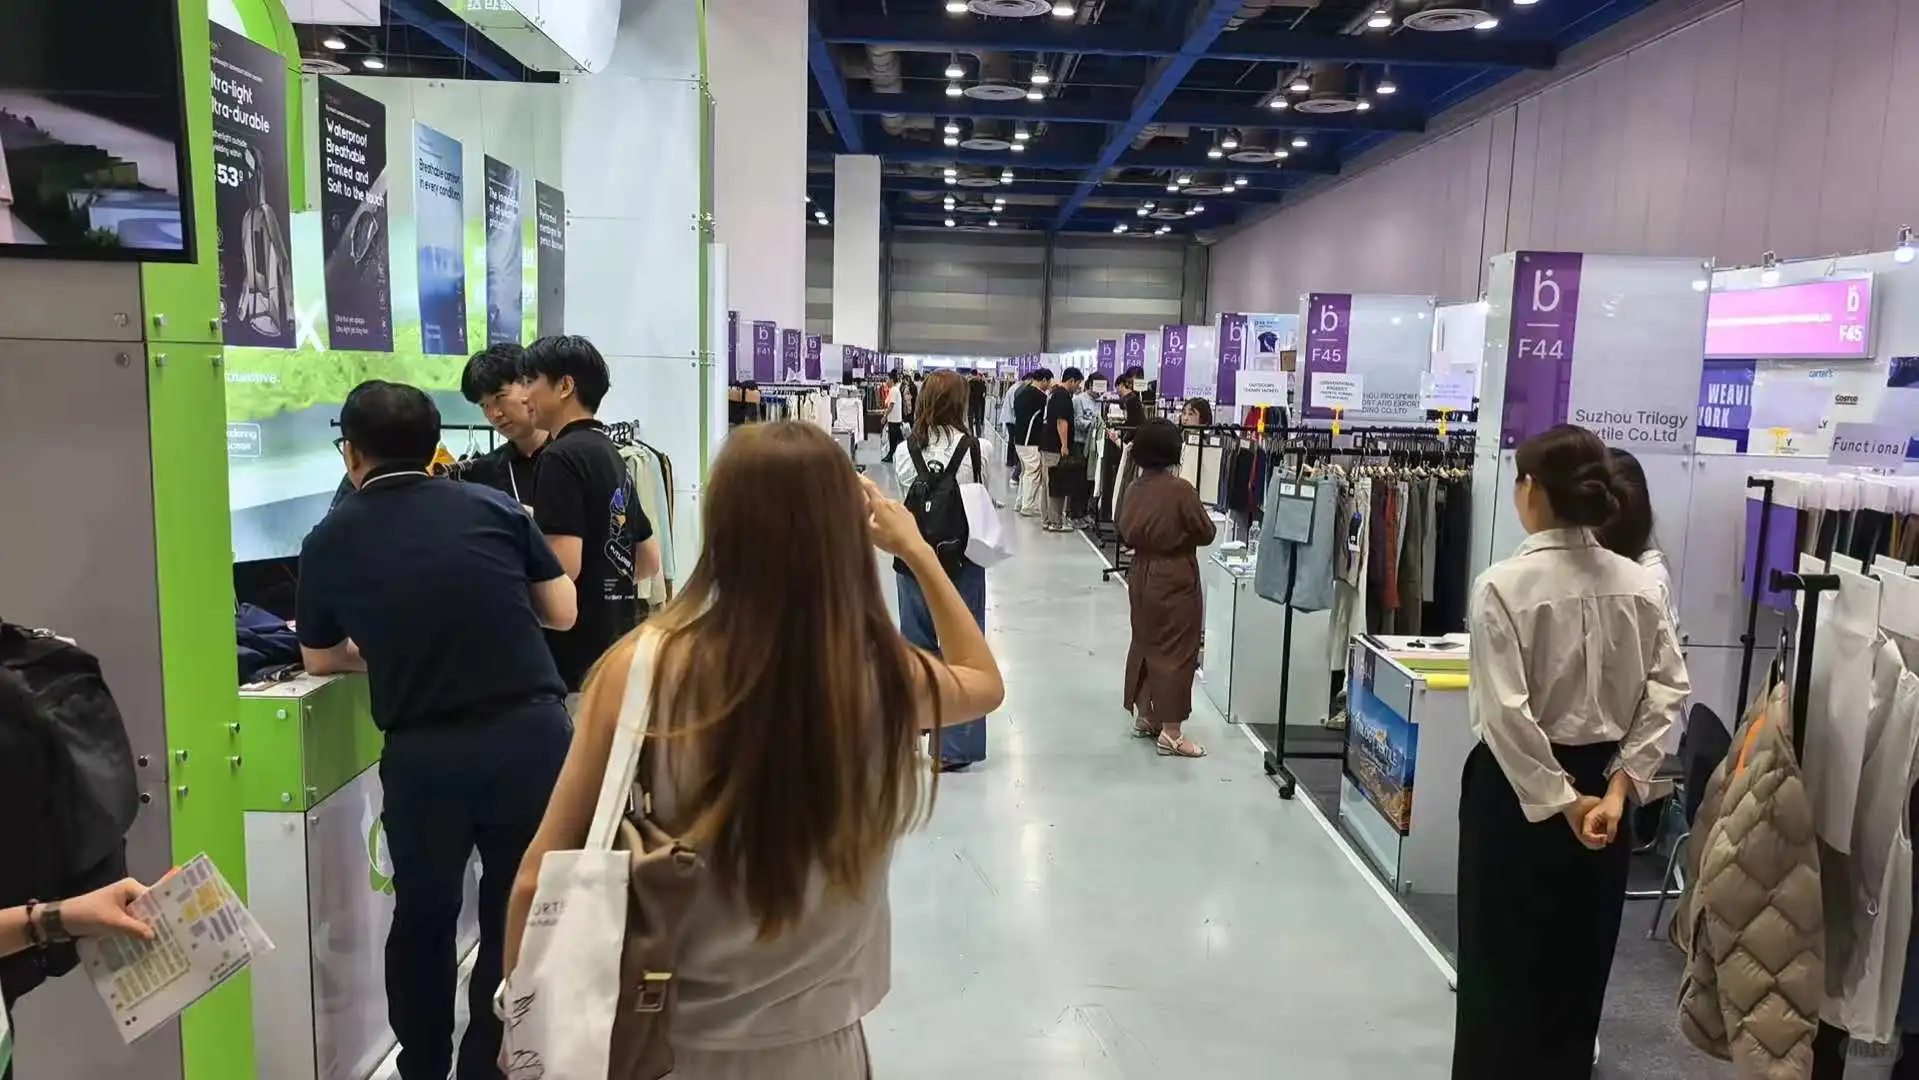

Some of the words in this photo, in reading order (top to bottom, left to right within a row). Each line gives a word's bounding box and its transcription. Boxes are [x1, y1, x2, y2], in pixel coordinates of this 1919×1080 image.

[211, 70, 253, 105] ltra-light
[211, 95, 270, 133] ltra-durable
[325, 117, 368, 148] Waterproof
[325, 137, 366, 165] Breathable
[326, 157, 353, 180] Printed
[355, 170, 369, 185] and
[327, 177, 343, 195] Soft
[344, 183, 352, 198] to
[352, 185, 365, 201] the
[365, 190, 385, 207] touch
[1839, 324, 1863, 343] F45
[757, 347, 771, 356] F41
[1312, 348, 1342, 362] F45
[1518, 339, 1564, 360] F44
[1164, 357, 1183, 367] F47
[1575, 409, 1632, 424] Suzhou
[1637, 411, 1688, 429] Trilogy
[1832, 436, 1906, 456] Functional
